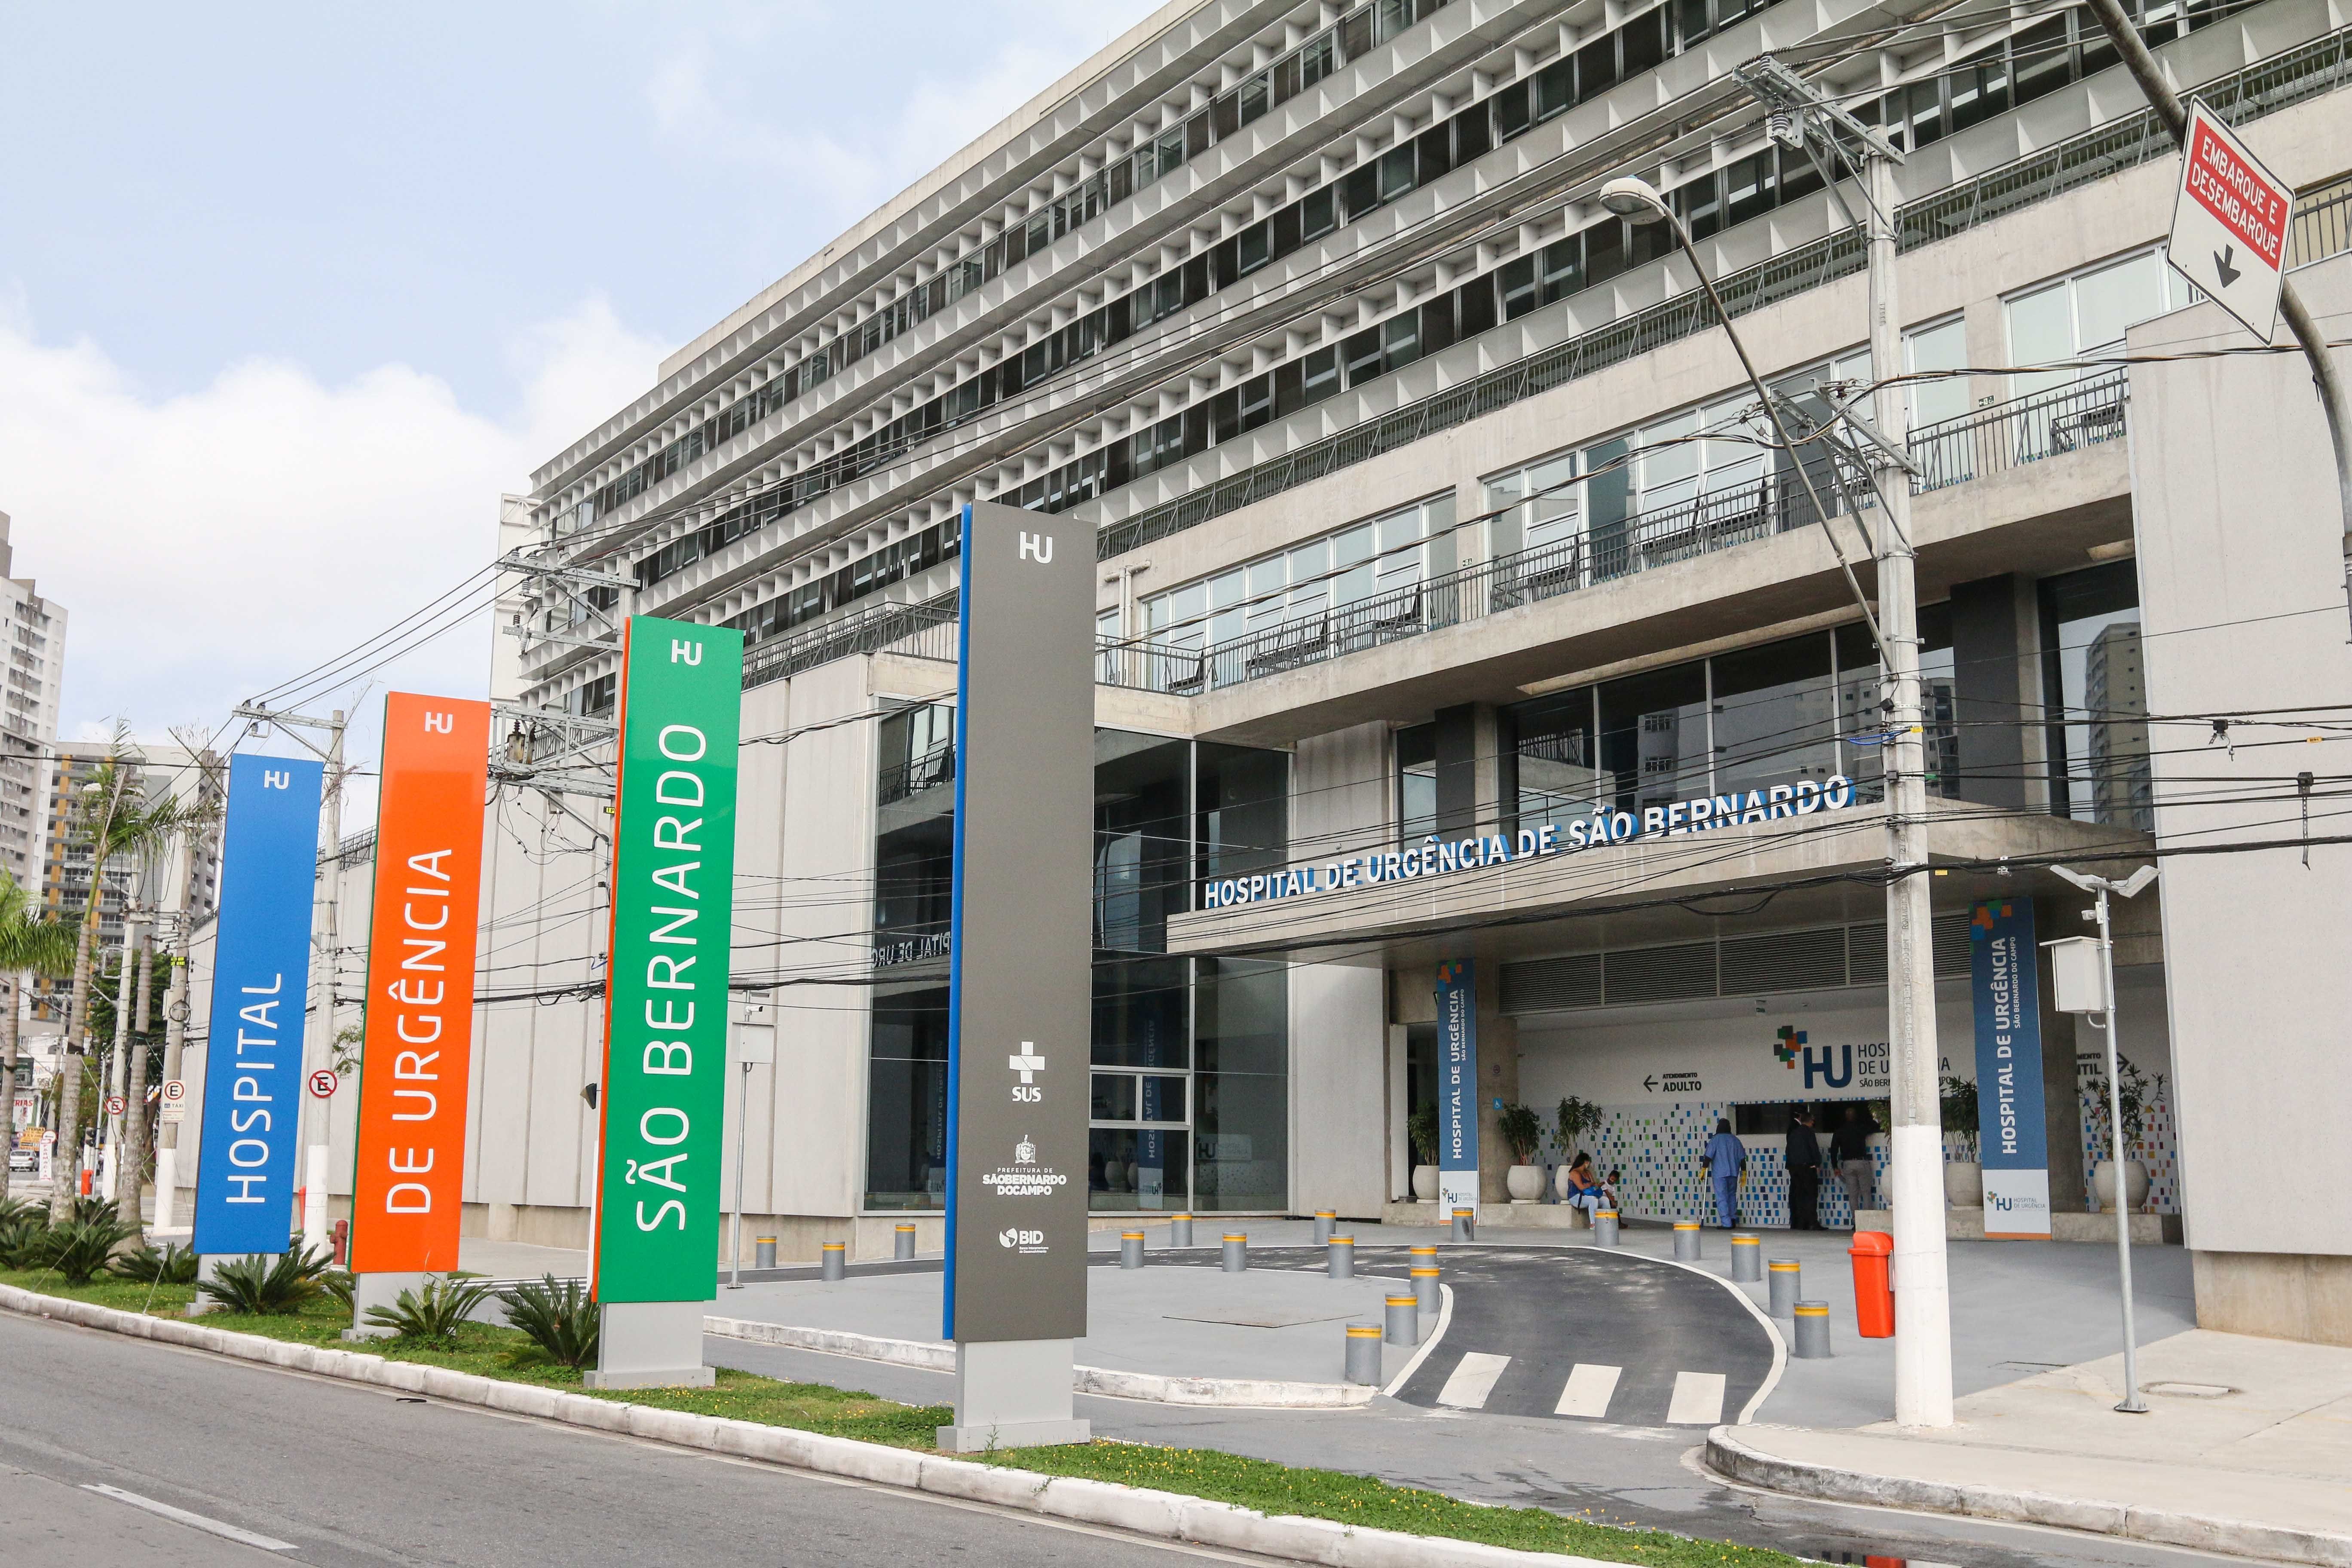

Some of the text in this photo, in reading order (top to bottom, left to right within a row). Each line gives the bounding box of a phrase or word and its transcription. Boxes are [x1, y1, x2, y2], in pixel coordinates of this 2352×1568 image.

[2202, 135, 2278, 225] EMBARQUE E
[2191, 161, 2278, 259] DESEMBARQUE
[1020, 531, 1053, 564] HU
[671, 639, 702, 666] HU
[424, 711, 453, 734] HU
[264, 770, 290, 790] HU
[1205, 774, 1853, 909] HOSPITAL DE URGÊNCIA DE SÃO BERNARDO
[625, 724, 706, 1231] SÃO BERNARDO
[2012, 962, 2017, 973] DO
[1461, 1009, 1465, 1017] DO
[386, 849, 452, 1213] DE URGÊNCIA
[1991, 937, 2017, 1154] HOSPITAL DE URGÊNCIA
[1449, 989, 1461, 1159] HOSPITAL DE URGÊNCIA
[1803, 1044, 1852, 1089] HU
[1859, 1061, 1876, 1075] DE
[169, 1085, 179, 1096] E
[226, 973, 281, 1203] HOSPITAL
[1012, 1086, 1041, 1102] SUS
[1663, 1081, 1702, 1092] ADULTO
[1860, 1078, 1873, 1087] SÃO
[1448, 1193, 1458, 1203] HU
[1996, 1197, 2012, 1211] HU
[1019, 1230, 1044, 1244] BID
